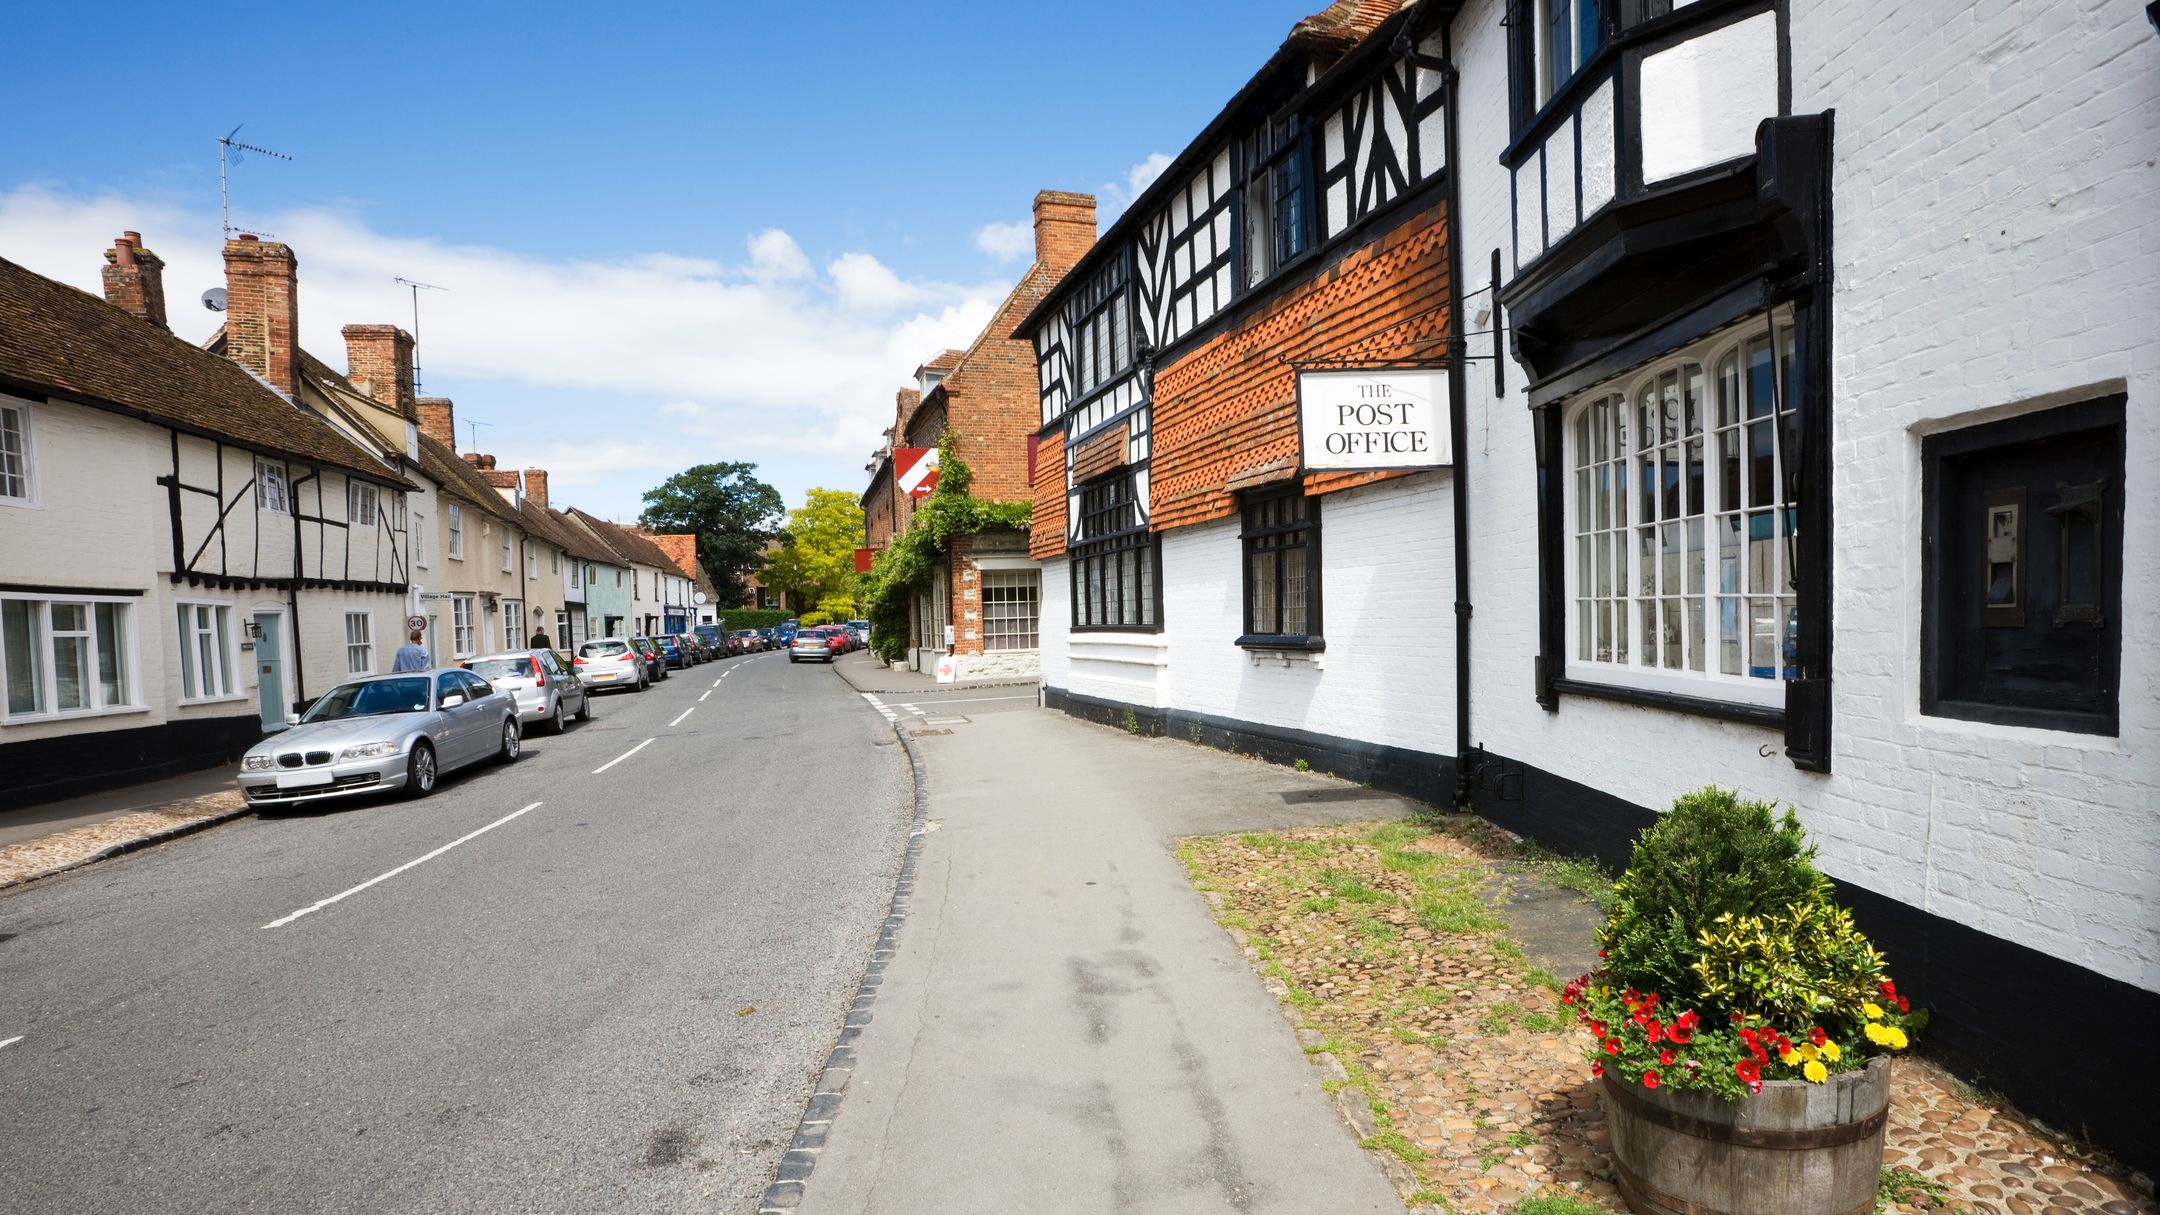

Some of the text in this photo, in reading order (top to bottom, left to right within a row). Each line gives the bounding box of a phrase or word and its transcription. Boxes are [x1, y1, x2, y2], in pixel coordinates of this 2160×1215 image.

[1357, 384, 1392, 398] THE
[1336, 403, 1415, 426] POST
[1325, 431, 1429, 455] OFFICE
[410, 619, 423, 627] 30
